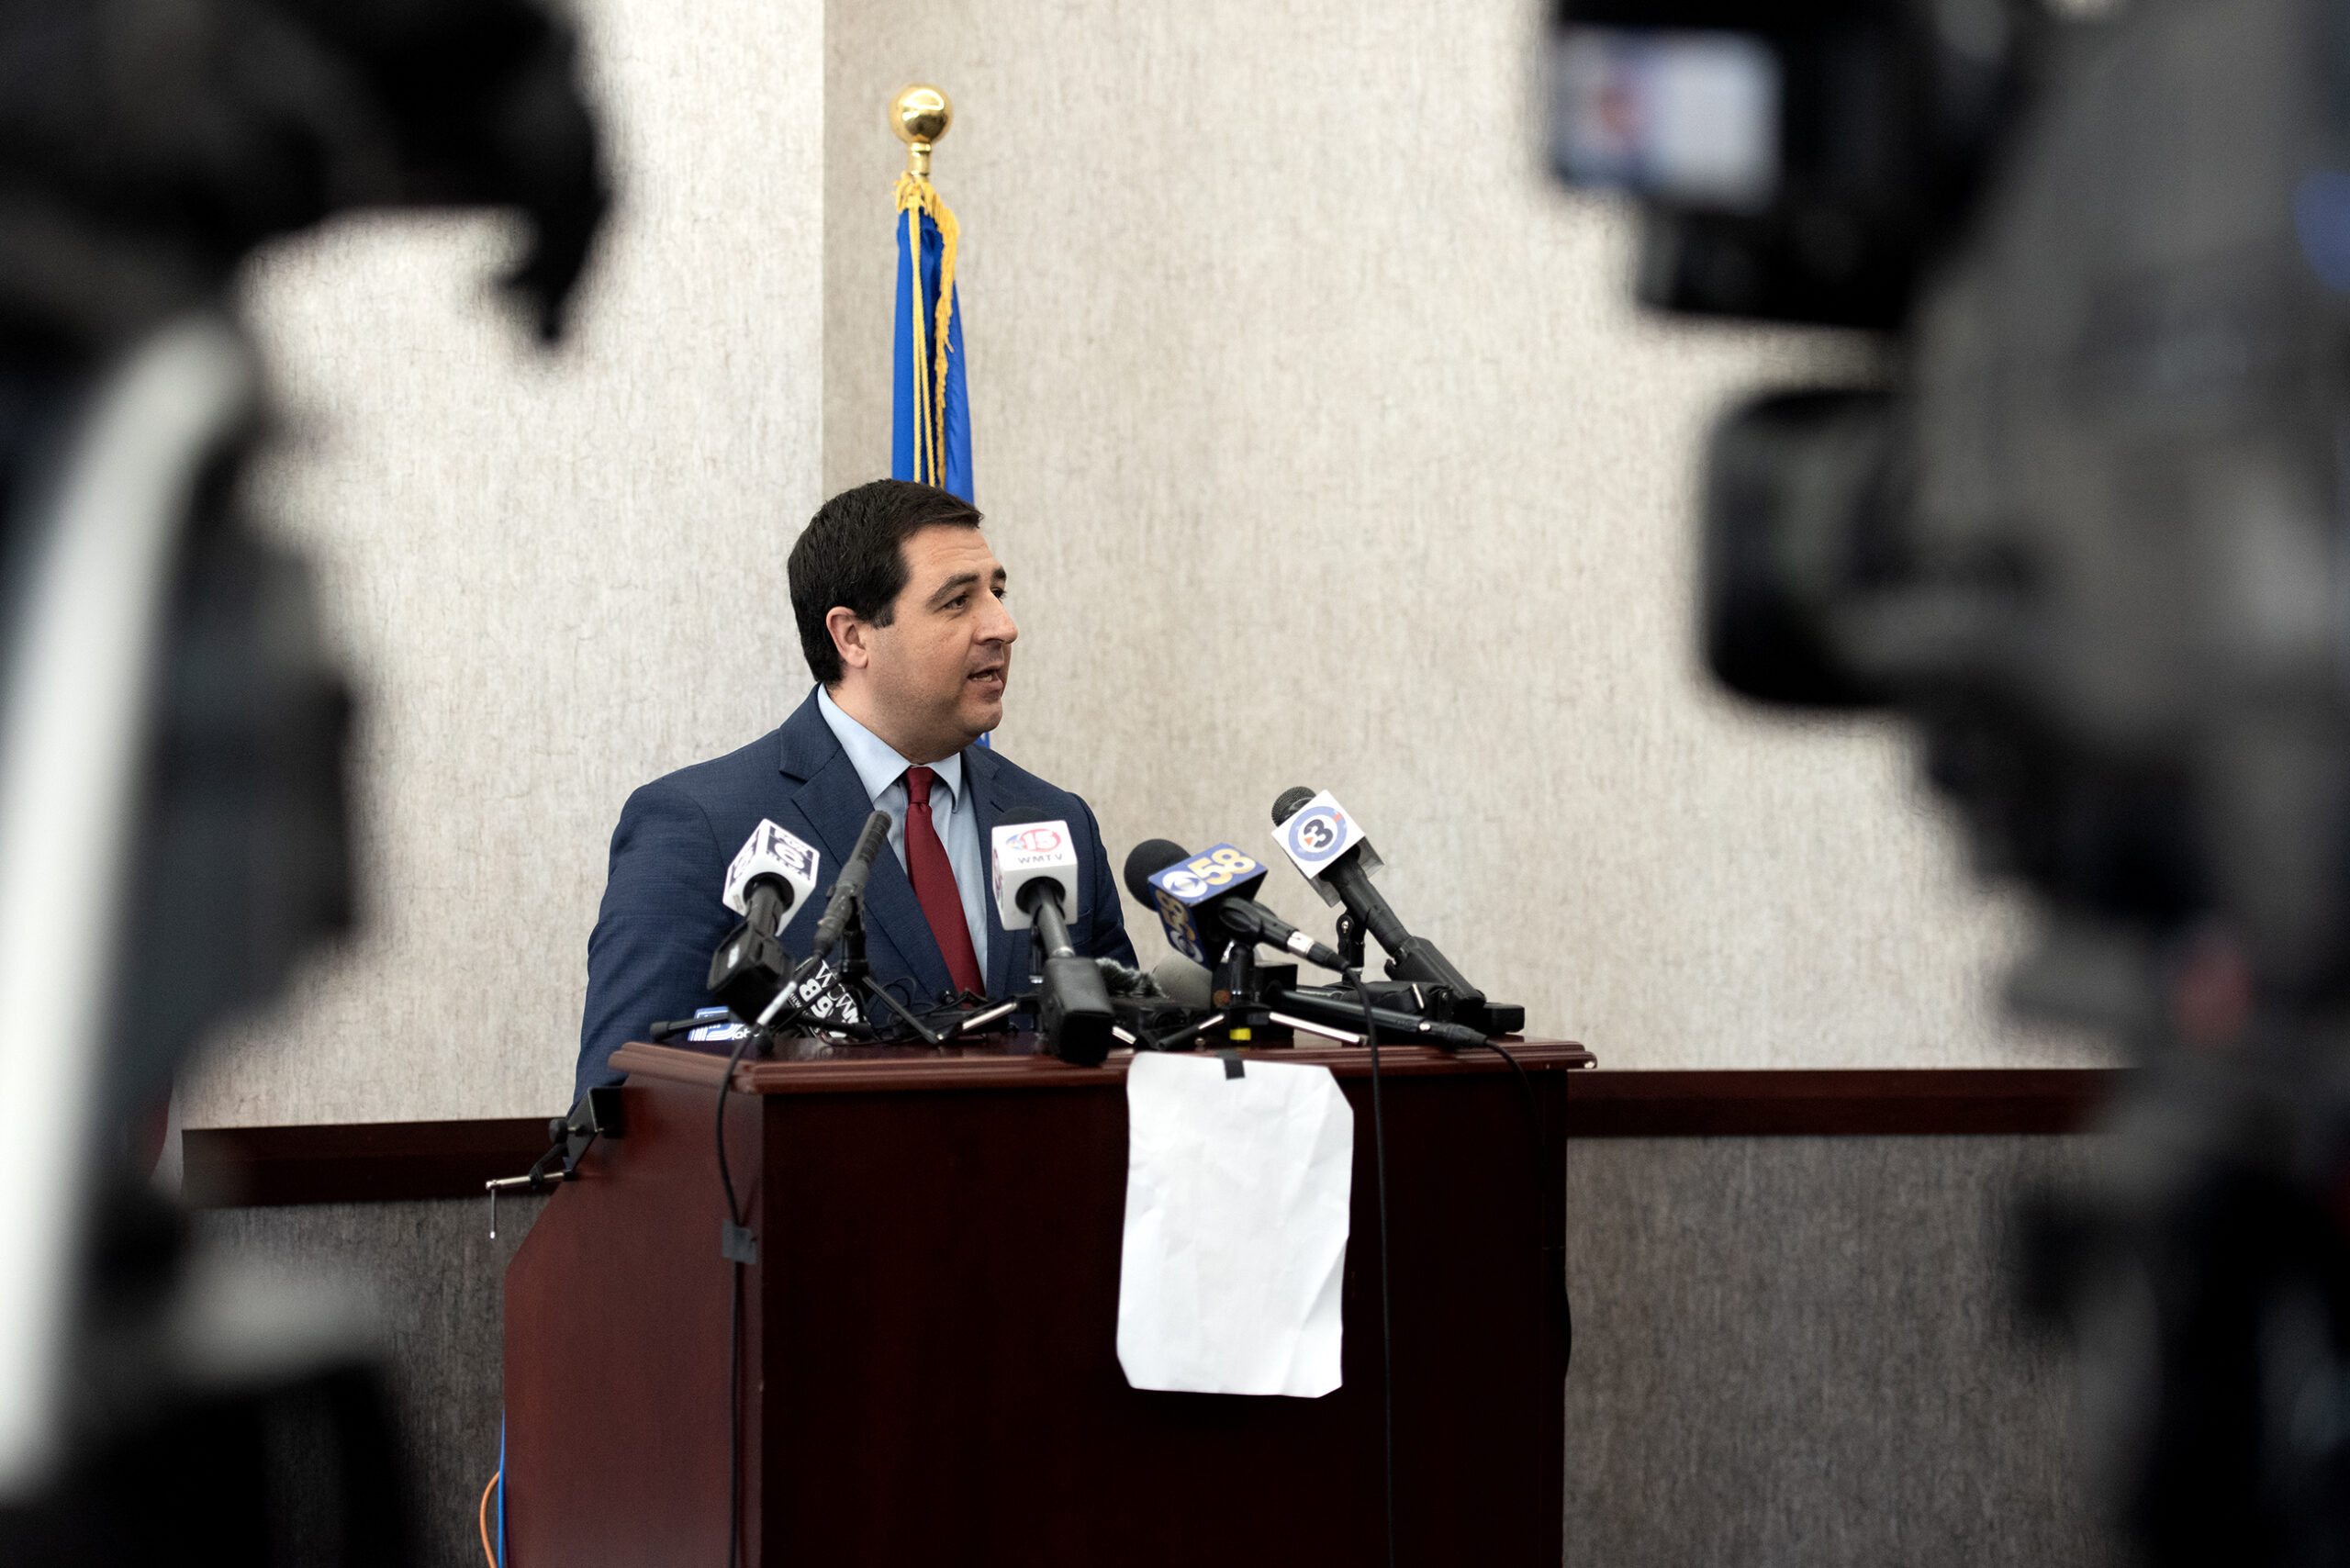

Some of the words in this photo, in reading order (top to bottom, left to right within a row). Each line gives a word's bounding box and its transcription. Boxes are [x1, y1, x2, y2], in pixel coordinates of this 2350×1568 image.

[1023, 830, 1057, 850] 15
[1304, 819, 1334, 848] 3
[774, 842, 805, 869] 6
[1017, 853, 1063, 865] WMTV
[1187, 848, 1257, 886] 58
